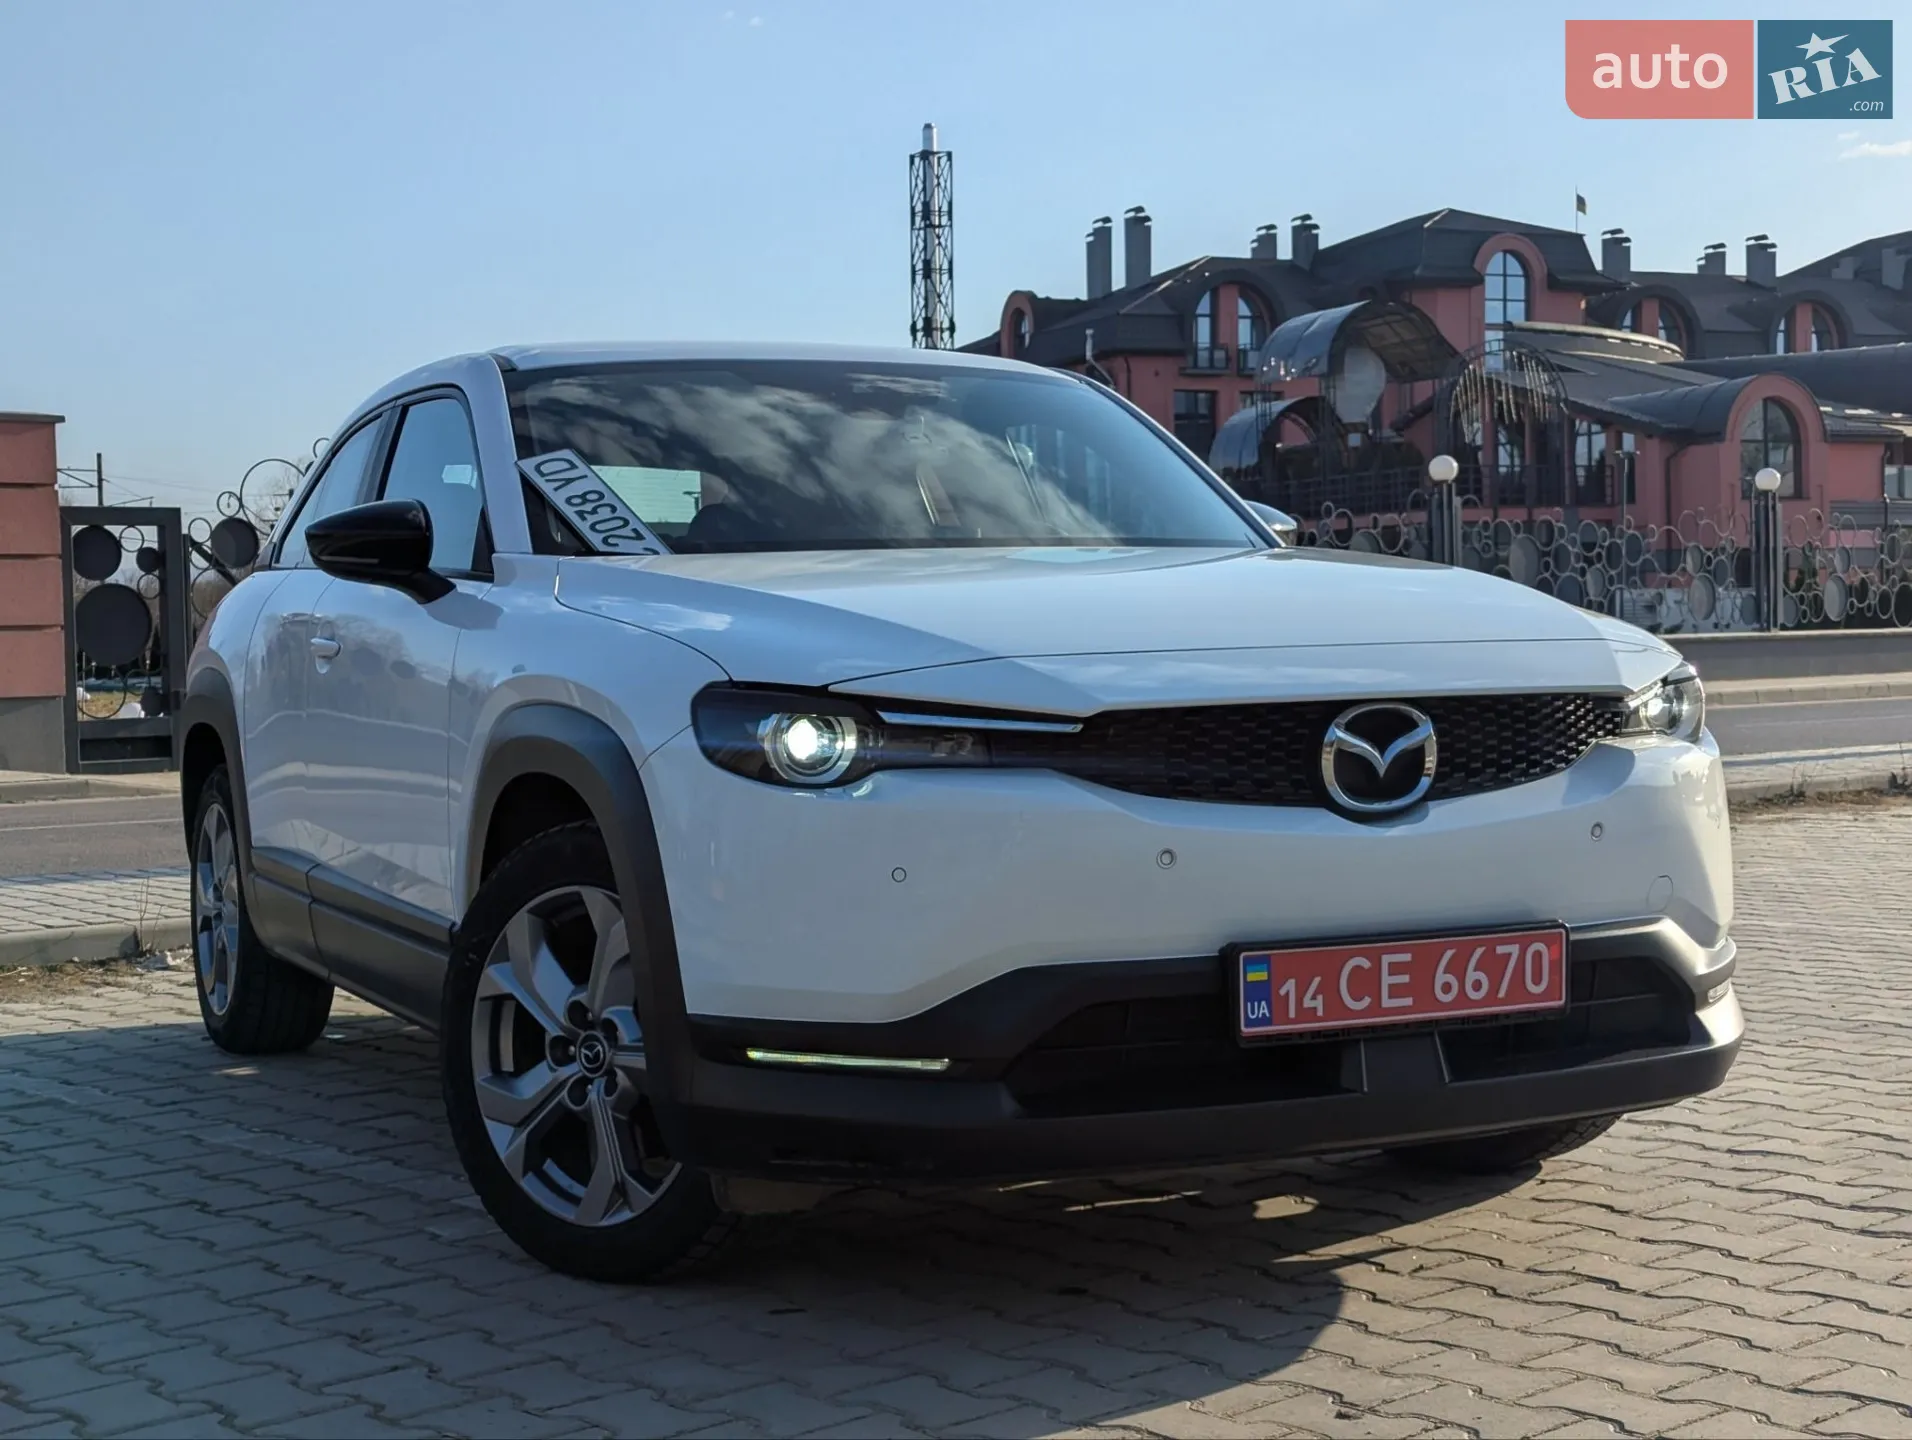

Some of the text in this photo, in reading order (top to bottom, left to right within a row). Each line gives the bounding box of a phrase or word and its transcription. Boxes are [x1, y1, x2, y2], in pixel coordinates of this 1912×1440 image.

[534, 458, 646, 547] 2038 YD
[1247, 1001, 1270, 1019] UA
[1279, 942, 1549, 1018] 14 CE 6670
